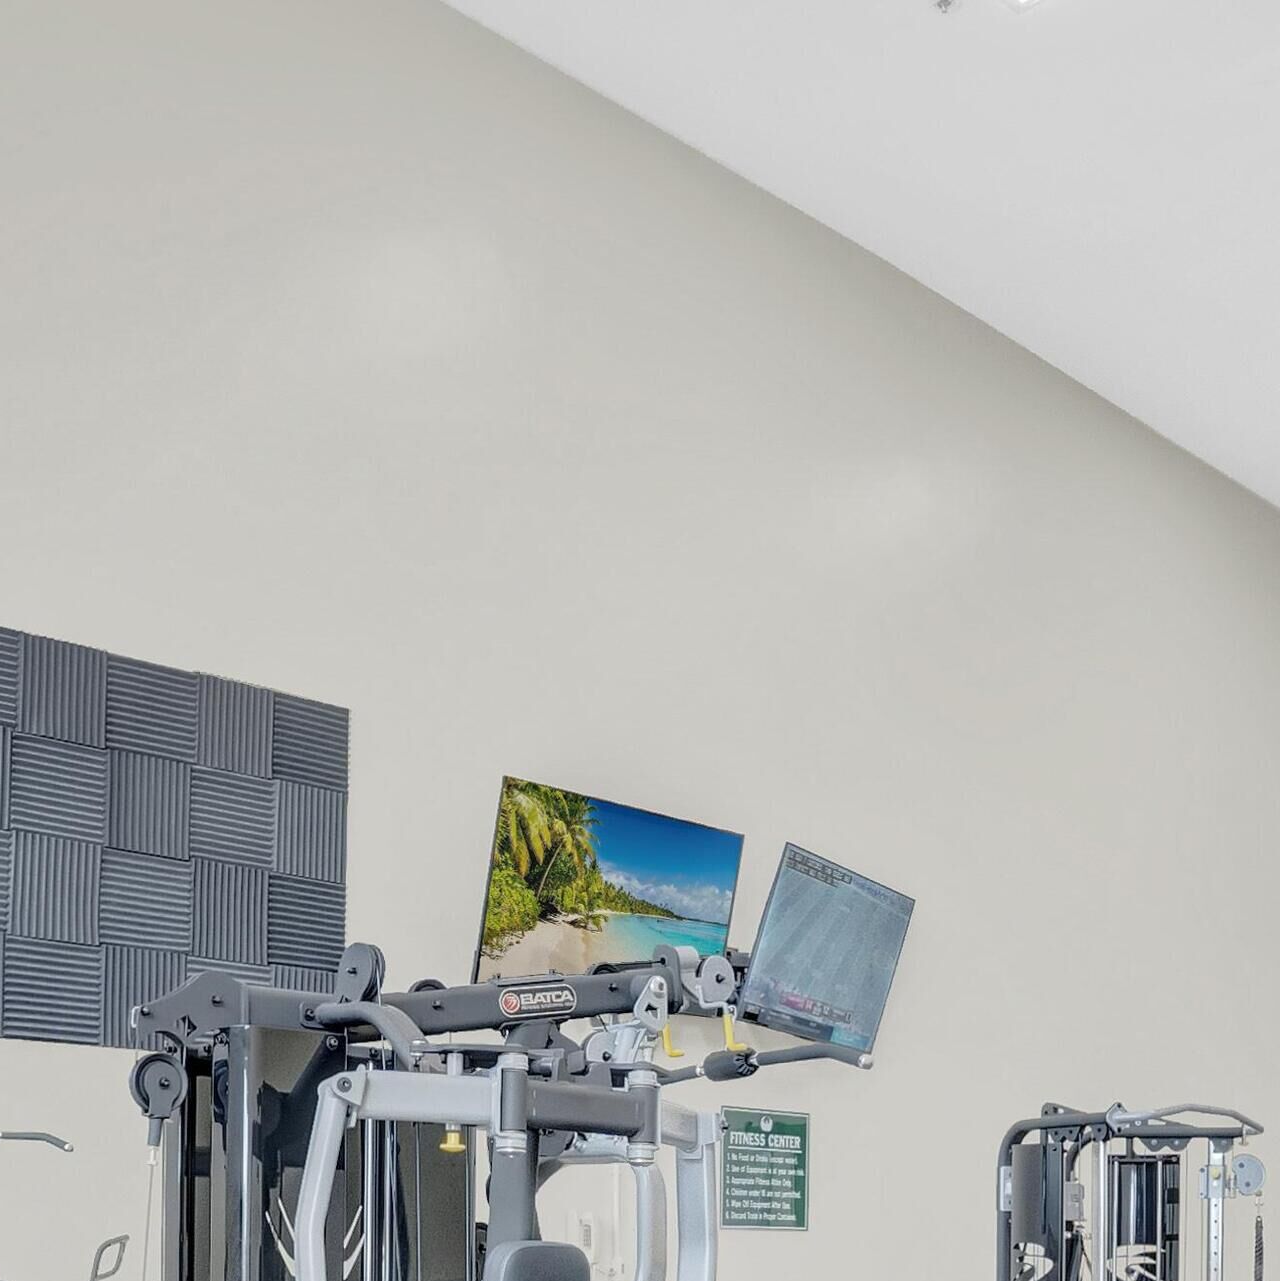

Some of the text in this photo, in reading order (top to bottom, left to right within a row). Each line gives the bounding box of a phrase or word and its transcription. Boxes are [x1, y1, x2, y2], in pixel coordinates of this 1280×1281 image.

[520, 990, 574, 1005] BATCA
[729, 1131, 801, 1149] FITNESS CENTER
